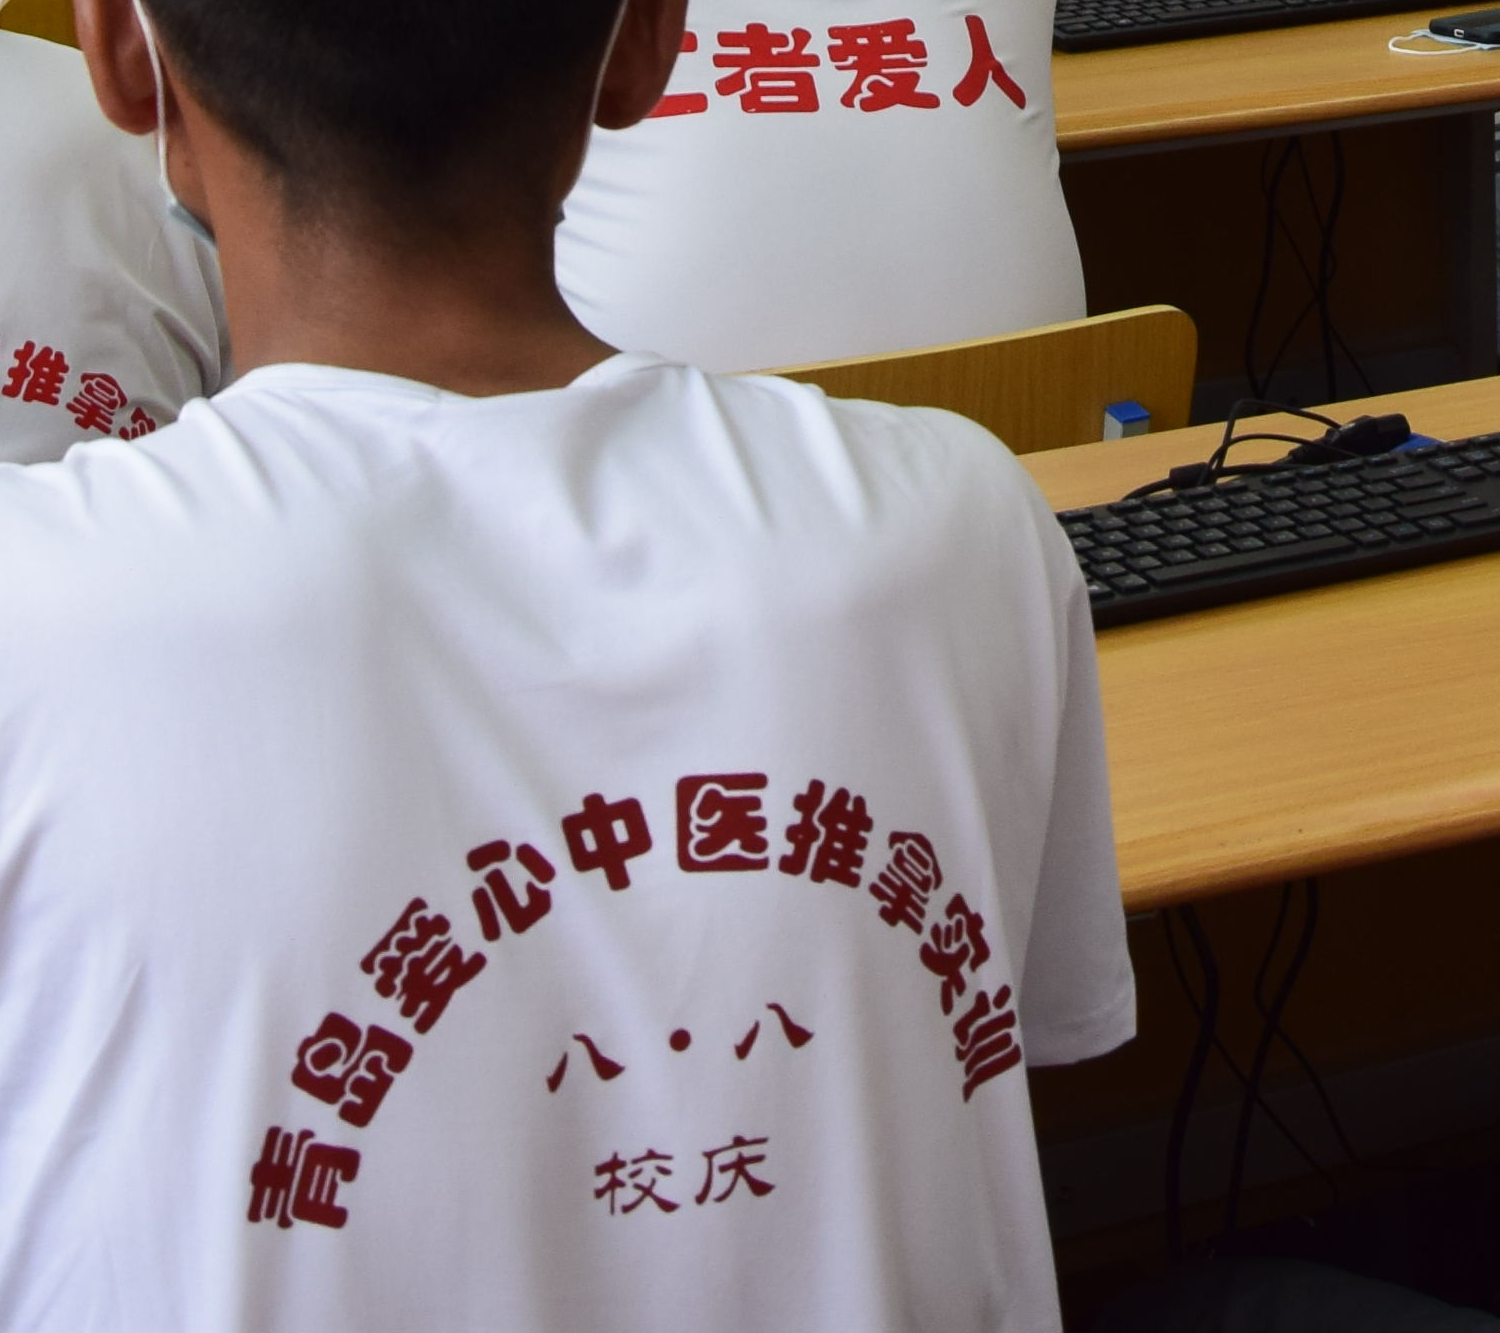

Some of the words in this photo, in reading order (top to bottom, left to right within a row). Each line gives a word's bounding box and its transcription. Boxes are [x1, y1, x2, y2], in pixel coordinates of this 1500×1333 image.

[246, 771, 1023, 1230] 青岛爱心中医推拿实训
[593, 1134, 778, 1217] 校庆
